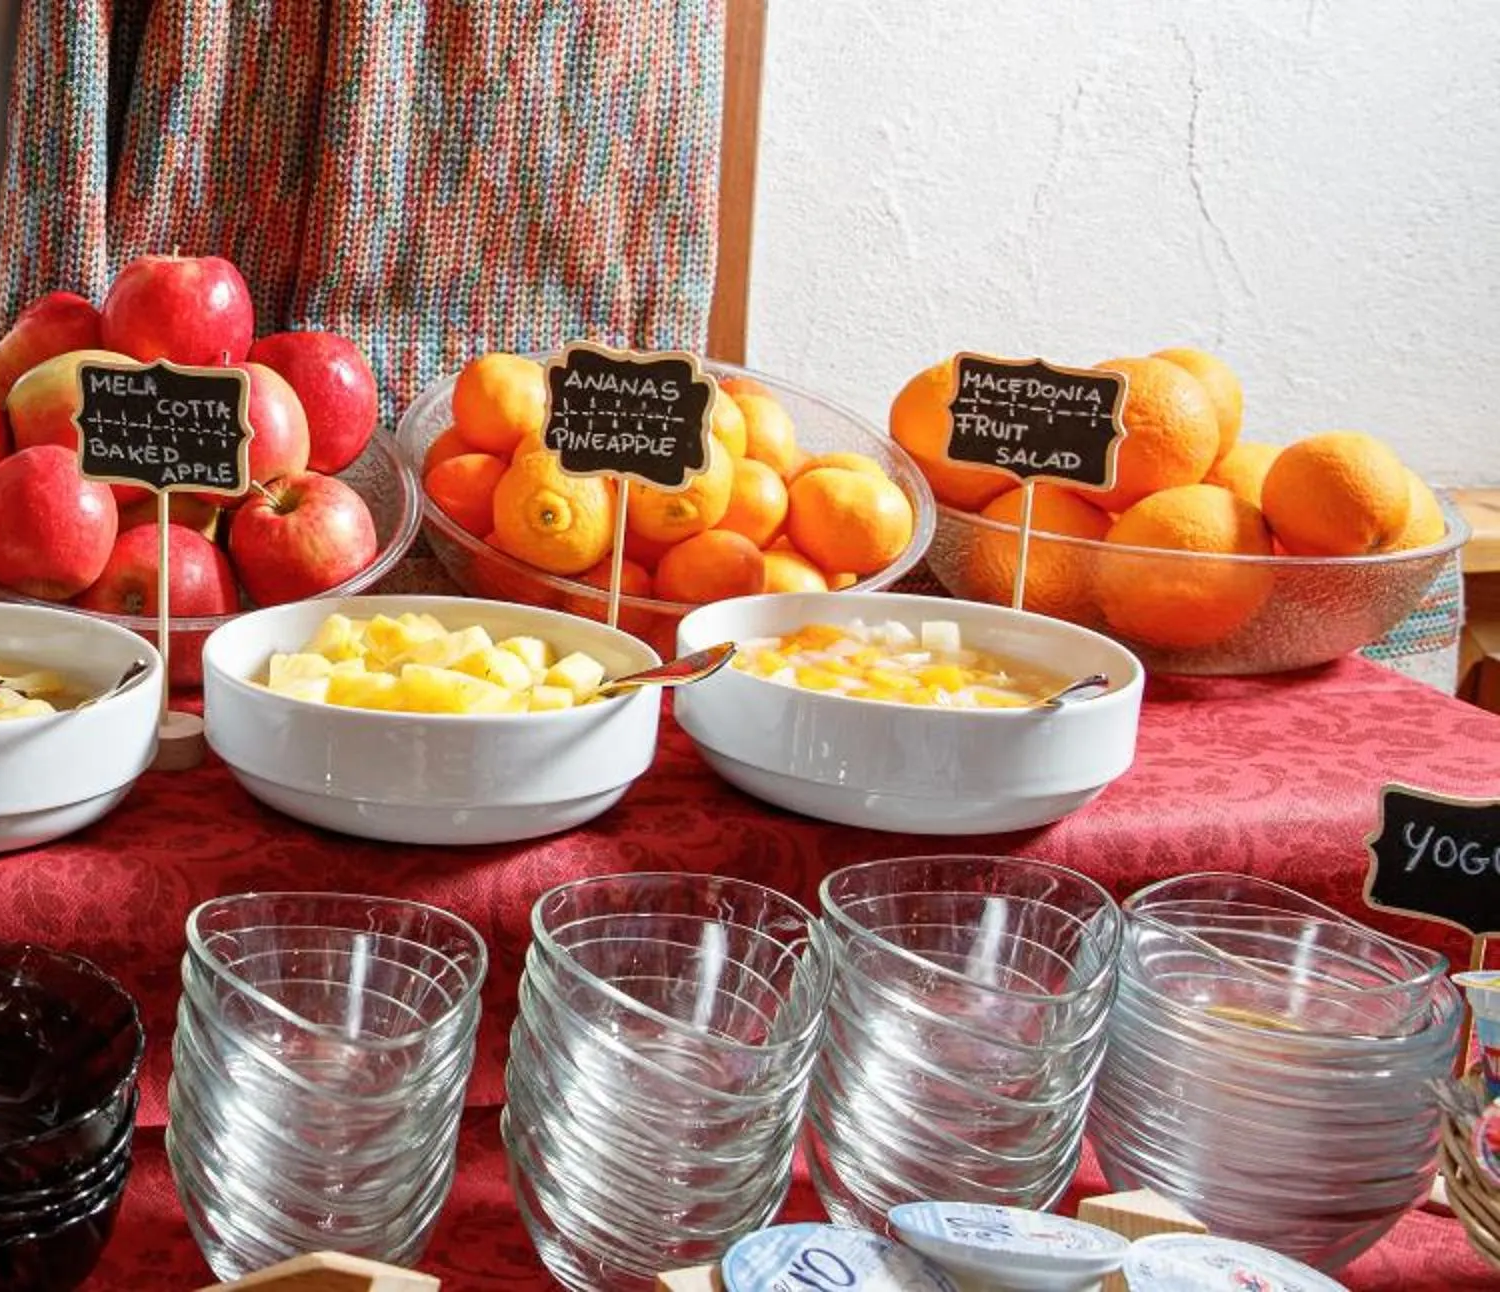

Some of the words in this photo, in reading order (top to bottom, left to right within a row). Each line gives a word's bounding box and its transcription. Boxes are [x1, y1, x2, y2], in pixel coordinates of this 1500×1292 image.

[89, 373, 158, 397] MELA
[564, 370, 680, 401] ANANAS
[963, 370, 1102, 404] MACEDONIA
[156, 399, 231, 420] COTTA
[955, 413, 1029, 441] FRUIT
[89, 438, 179, 464] BAKED
[550, 427, 677, 456] PINEAPPLE
[996, 447, 1081, 469] SALAD
[160, 463, 233, 483] APPLE
[1403, 822, 1500, 875] YOG
